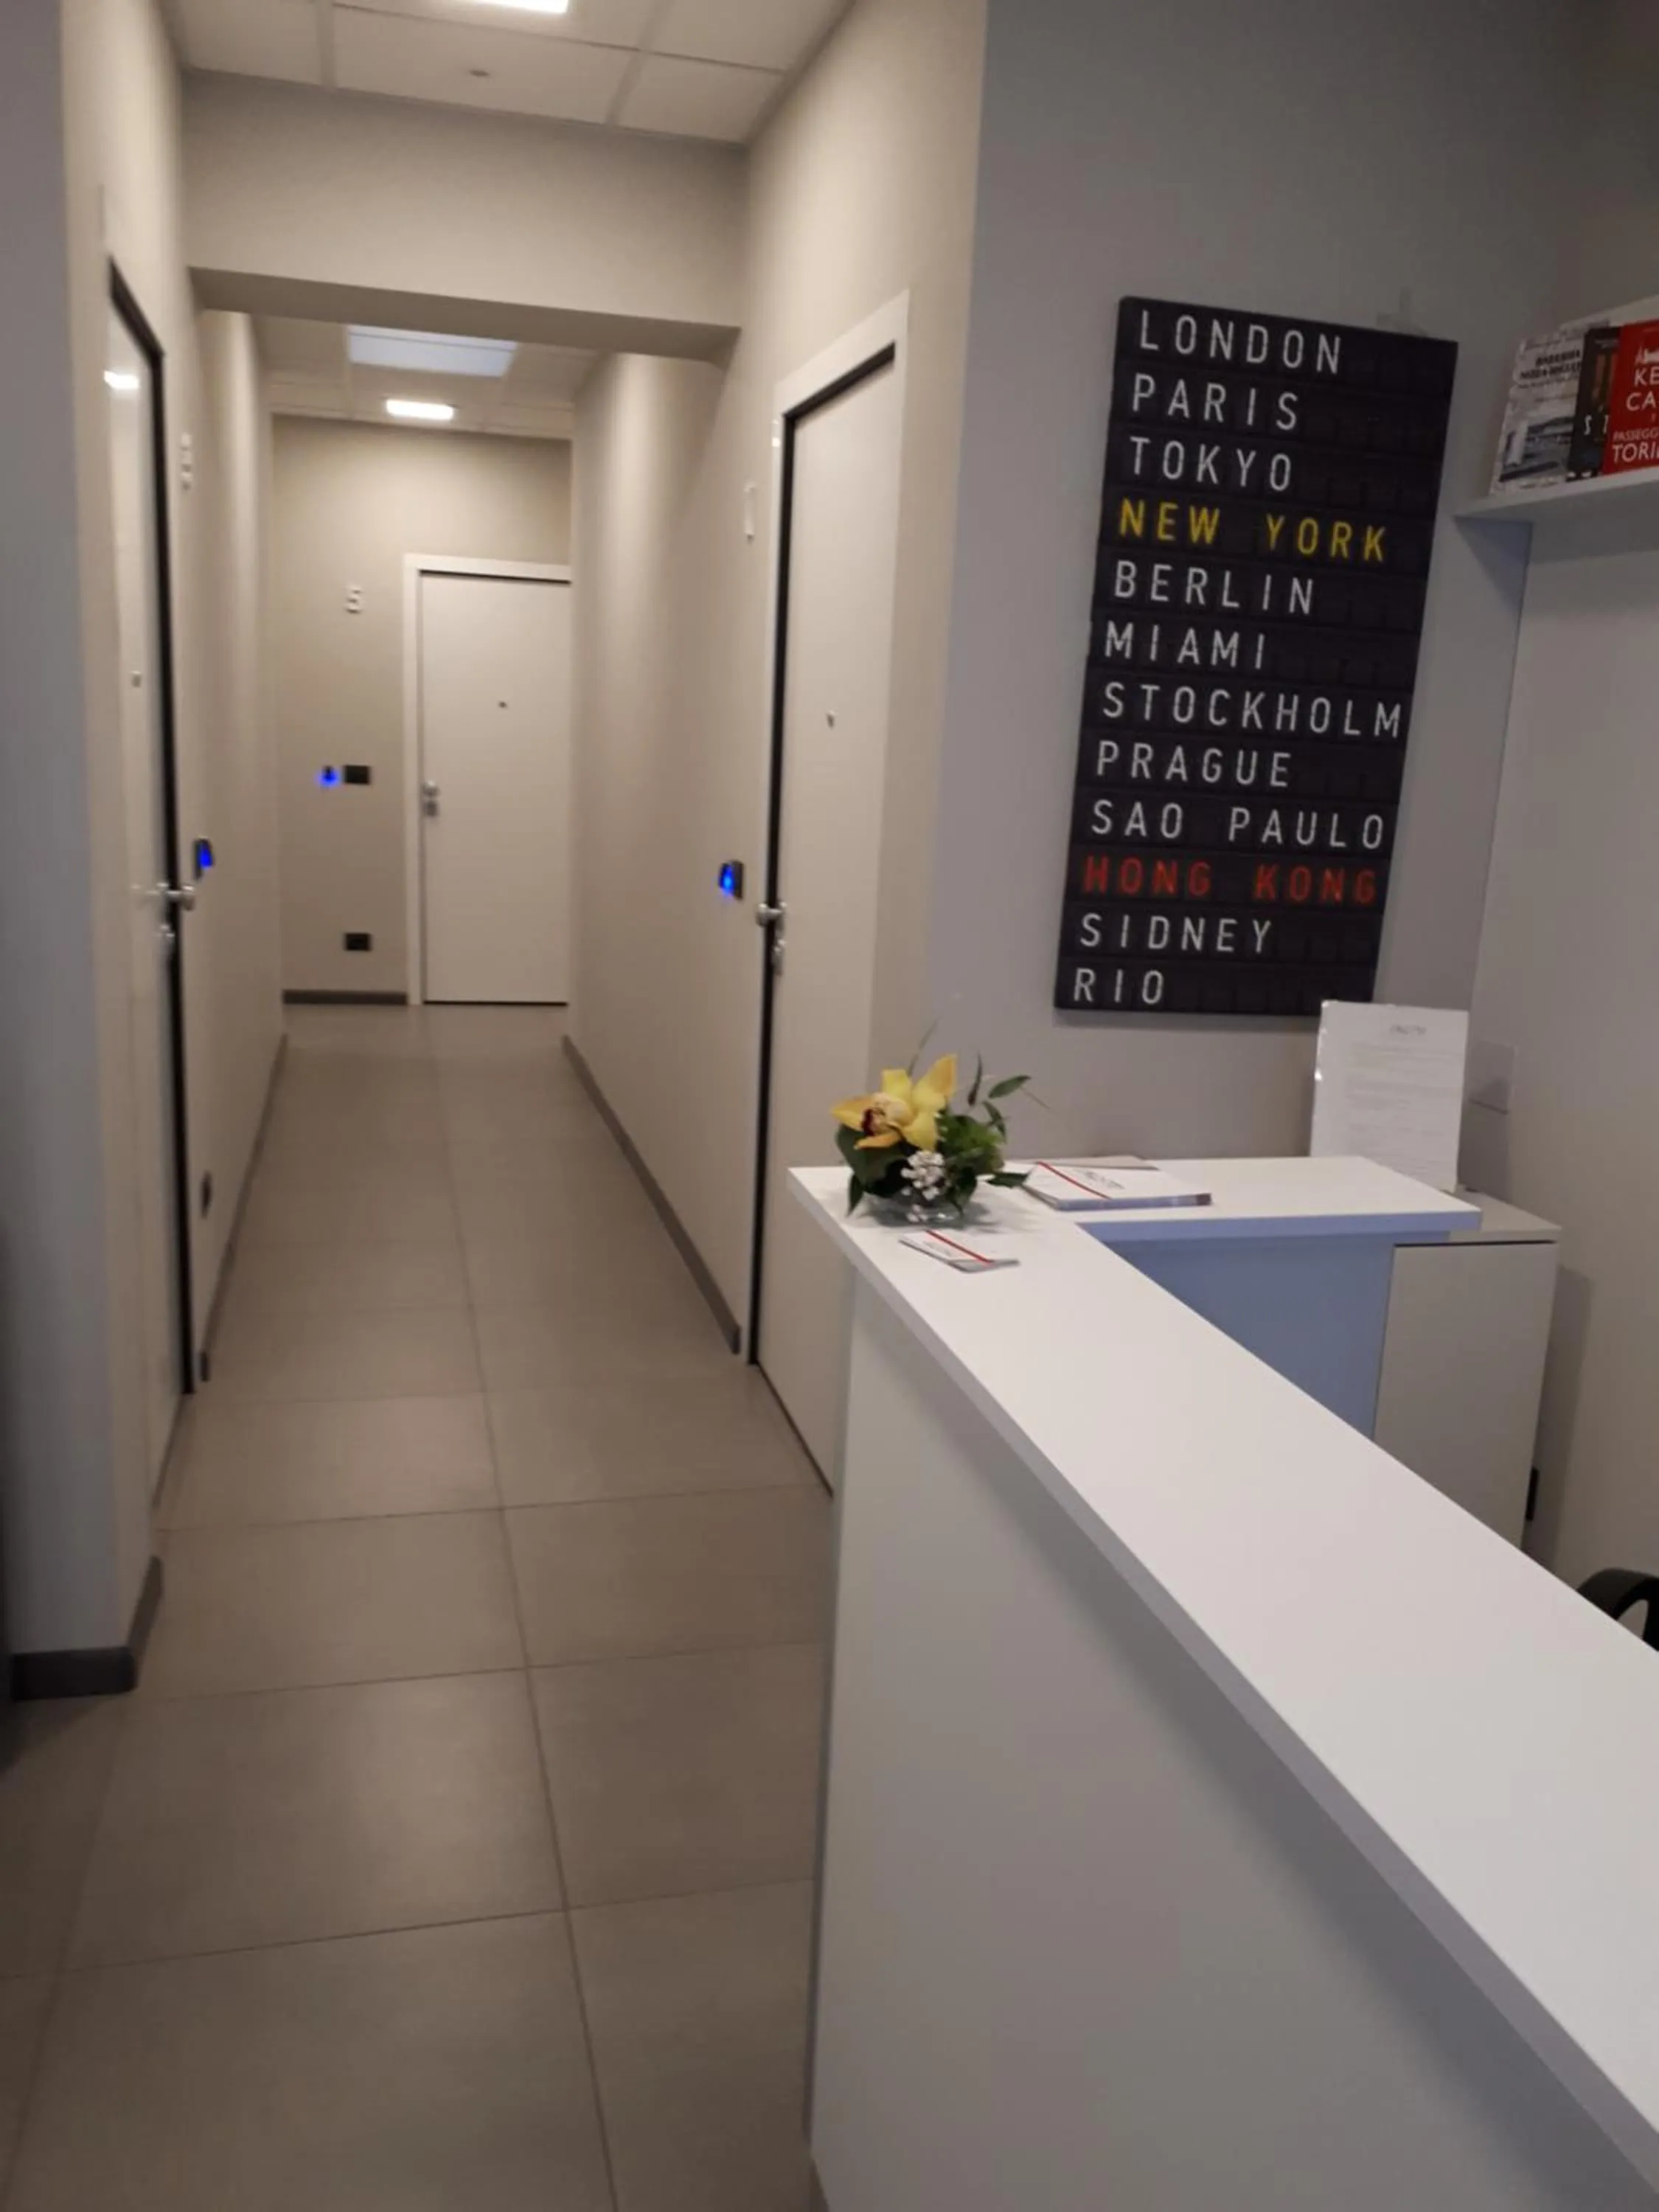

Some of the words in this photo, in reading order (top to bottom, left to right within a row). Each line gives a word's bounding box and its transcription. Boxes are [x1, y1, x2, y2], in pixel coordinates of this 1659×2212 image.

[1140, 310, 1340, 374] LONDON
[1132, 372, 1298, 431] PARIS
[1625, 390, 1659, 411] CA
[1130, 435, 1291, 492] TOKYO
[1612, 441, 1659, 464] TORI
[1119, 498, 1220, 545] NEW
[1265, 513, 1386, 562] YORK
[1114, 559, 1313, 615] BERLIN
[1105, 620, 1265, 669] MIAMI
[1102, 681, 1401, 738] STOCKHOLM
[1096, 740, 1291, 787] PRAGUE
[1091, 799, 1183, 839] SAO
[1228, 806, 1383, 850] PAULO
[1083, 855, 1211, 897] HONG
[1253, 863, 1376, 903] KONG
[1079, 912, 1271, 953] SIDNEY
[1073, 967, 1164, 1005] RIO
